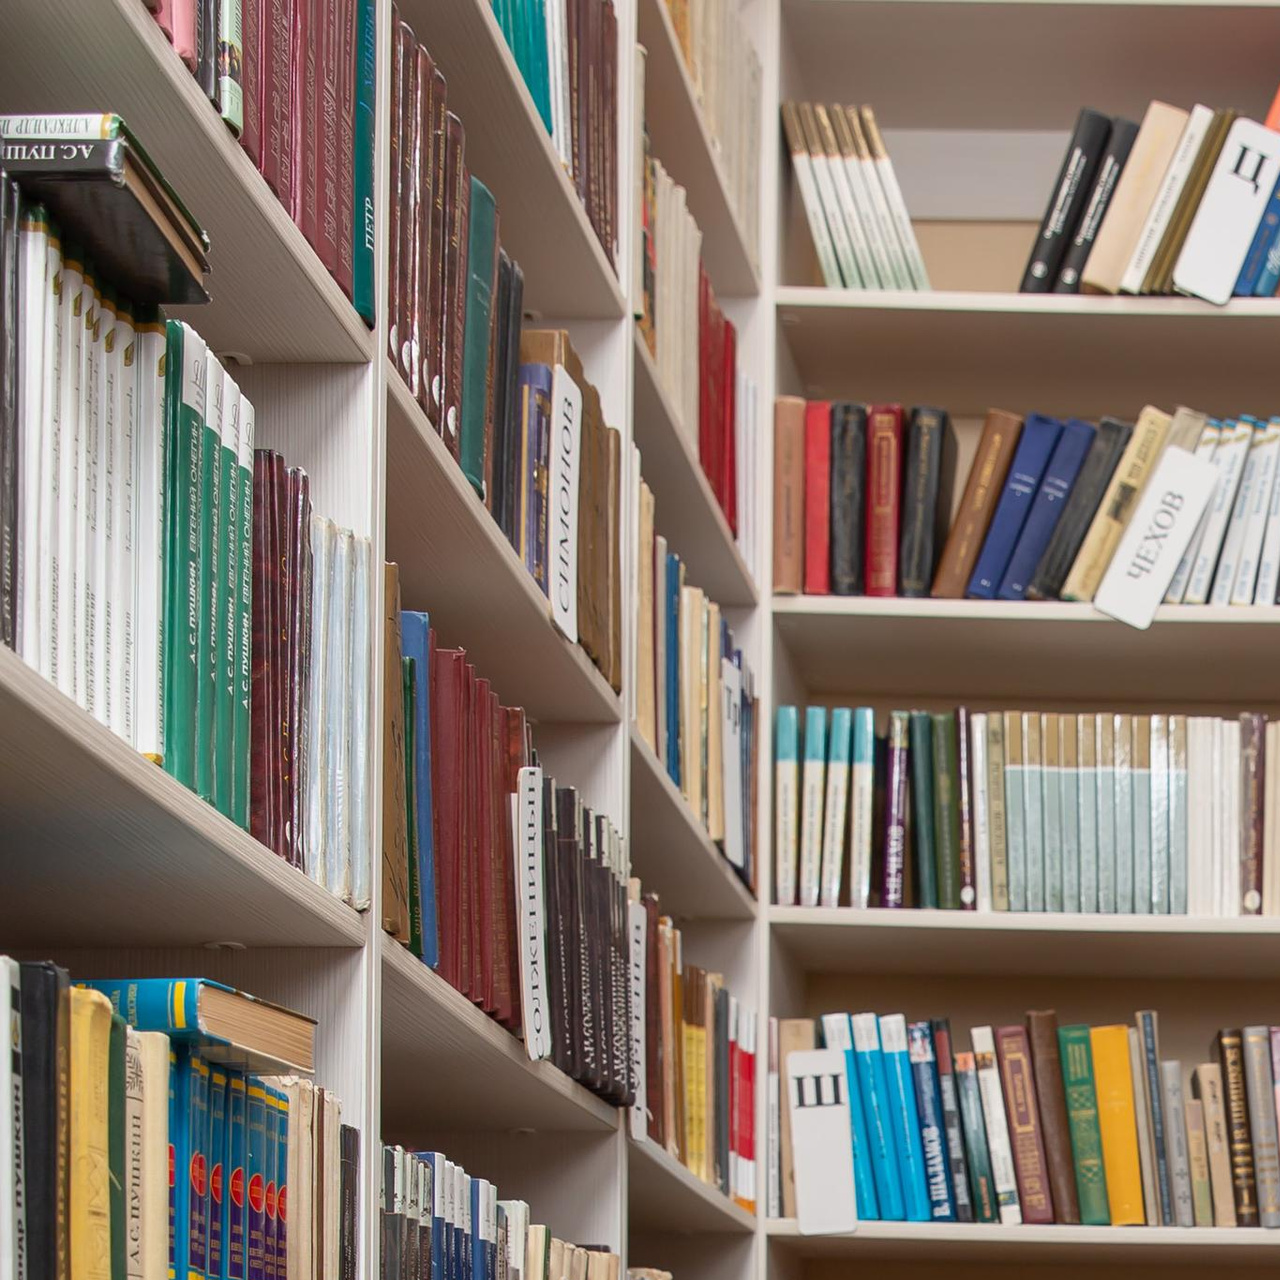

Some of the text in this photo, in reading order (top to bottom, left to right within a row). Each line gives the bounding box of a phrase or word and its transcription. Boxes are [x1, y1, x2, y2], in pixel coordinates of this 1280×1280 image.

[1233, 144, 1270, 193] Ц
[188, 420, 199, 484] ОНЕГИН
[210, 443, 220, 505] ОНЕГИН
[188, 486, 199, 553] ЕВГЕНИЙ
[228, 460, 238, 522] ОНЕГИН
[243, 479, 253, 539] ОНЕГИН
[557, 396, 578, 614] СИМОНОВ
[227, 523, 237, 590] ЕВГЕНИЙ
[1126, 489, 1184, 582] ЧЕХОВ
[188, 560, 199, 629] ПУШКИН
[242, 540, 252, 605] ЕВГЕНИЙ
[226, 595, 236, 662] ПУШКИН
[241, 611, 251, 676] ПУШКИН
[525, 768, 548, 1062] СОЛЖЕНИЦЫН
[794, 1074, 846, 1109] Ш
[11, 1083, 26, 1208] ПУШКИН
[128, 1114, 144, 1265] А.С. ПУШКИН
